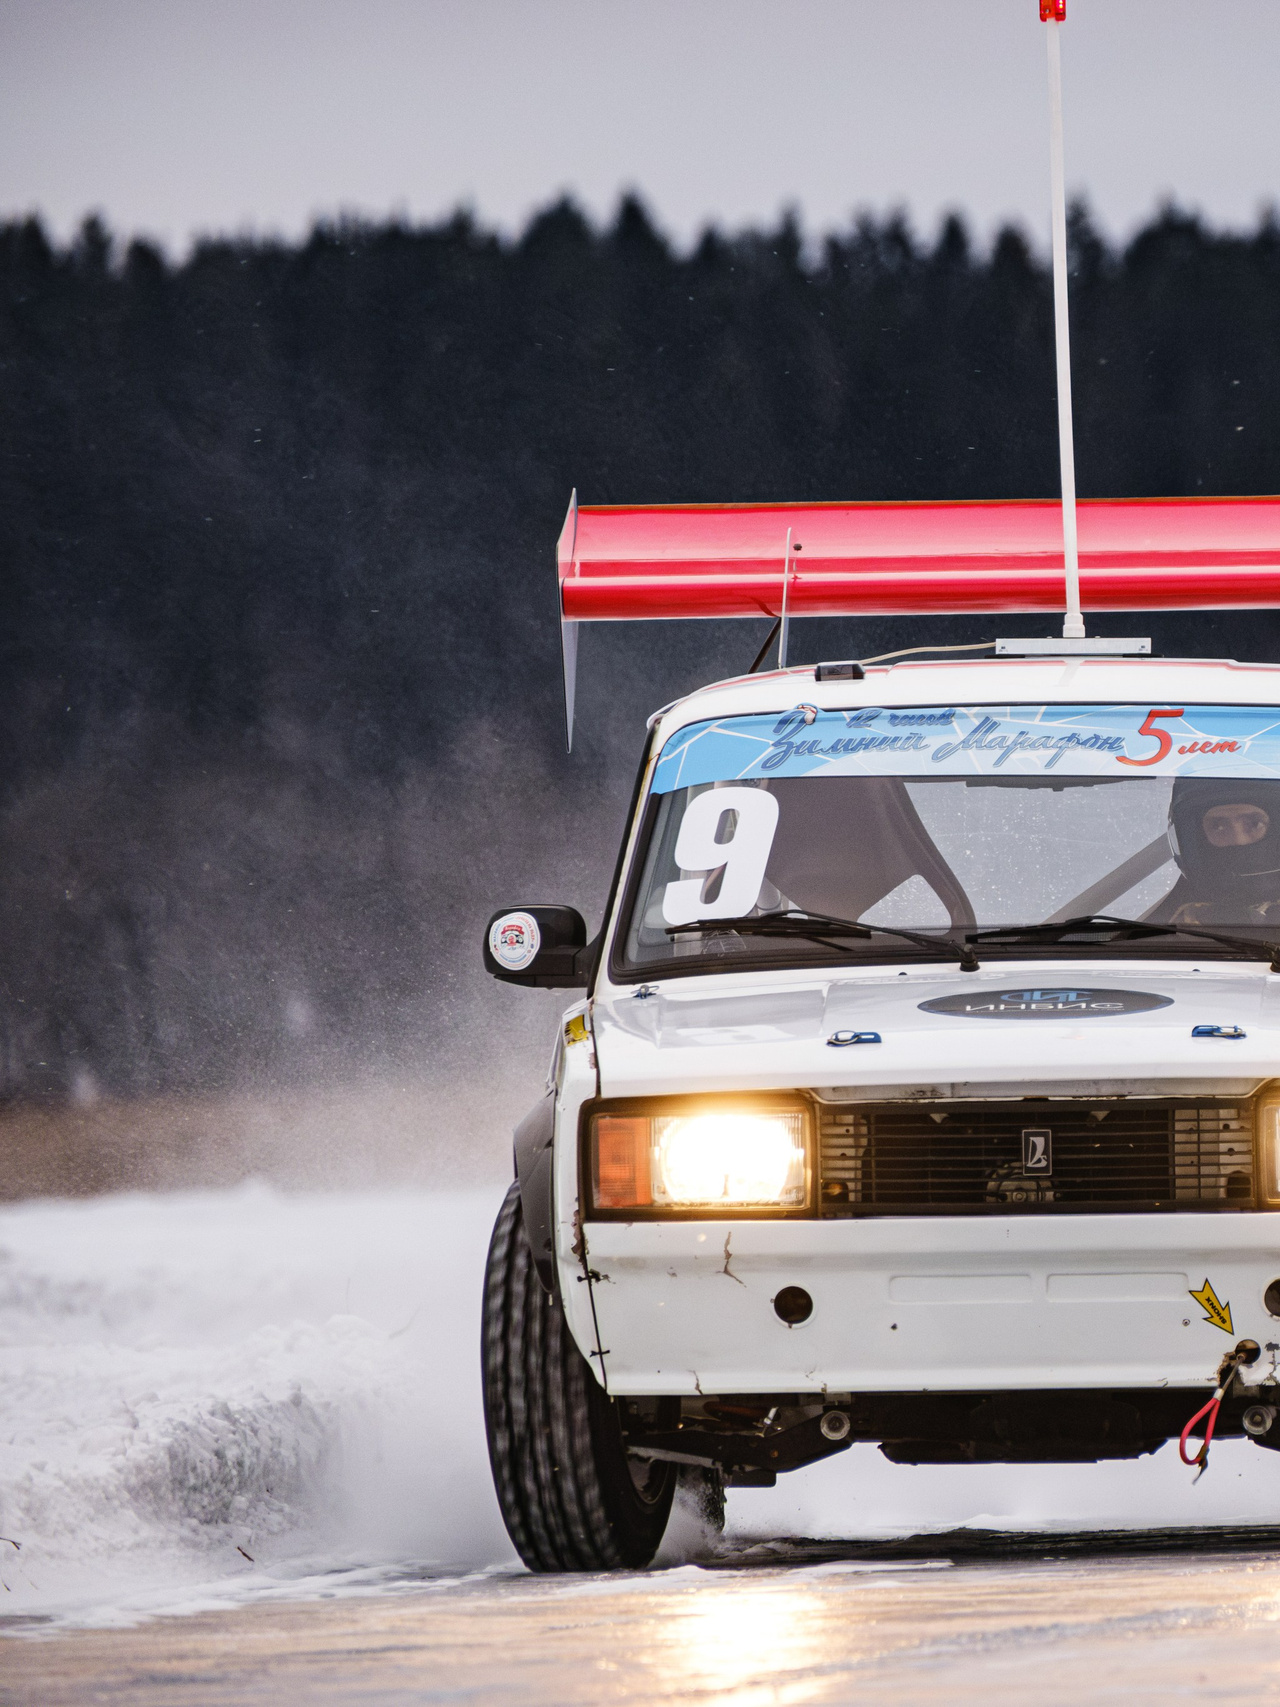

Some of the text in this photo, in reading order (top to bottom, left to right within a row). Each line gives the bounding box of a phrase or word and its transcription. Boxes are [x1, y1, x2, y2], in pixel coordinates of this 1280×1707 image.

[761, 708, 1243, 771] Зимний Марафон 5 лет
[845, 708, 883, 728] 12
[662, 786, 780, 927] 9
